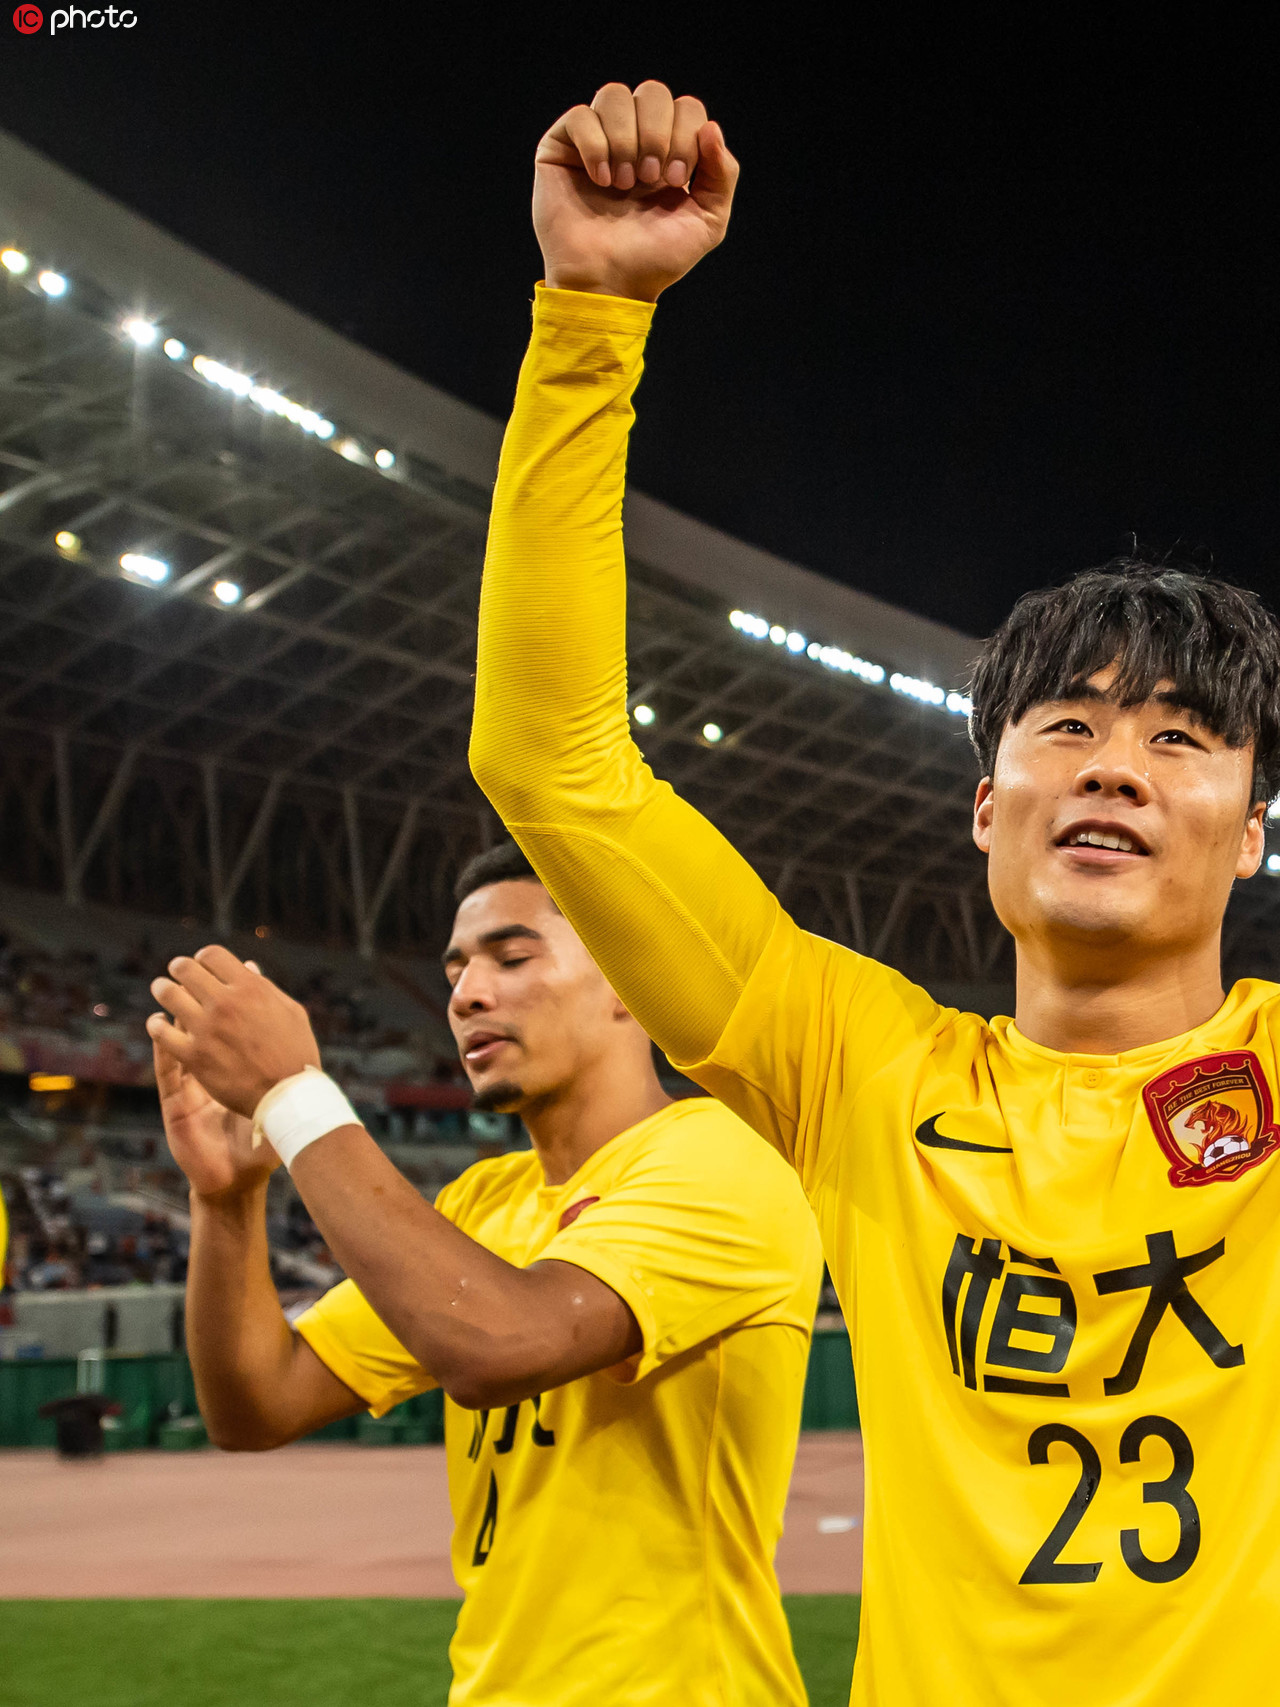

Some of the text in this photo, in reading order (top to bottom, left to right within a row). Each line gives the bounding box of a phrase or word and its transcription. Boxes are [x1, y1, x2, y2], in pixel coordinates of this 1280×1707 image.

[1167, 1078, 1245, 1112] BE THE BEST FOREVER
[1205, 1152, 1252, 1174] GUANGZHOU
[942, 1230, 1246, 1398] 恒大
[1018, 1415, 1202, 1584] 23
